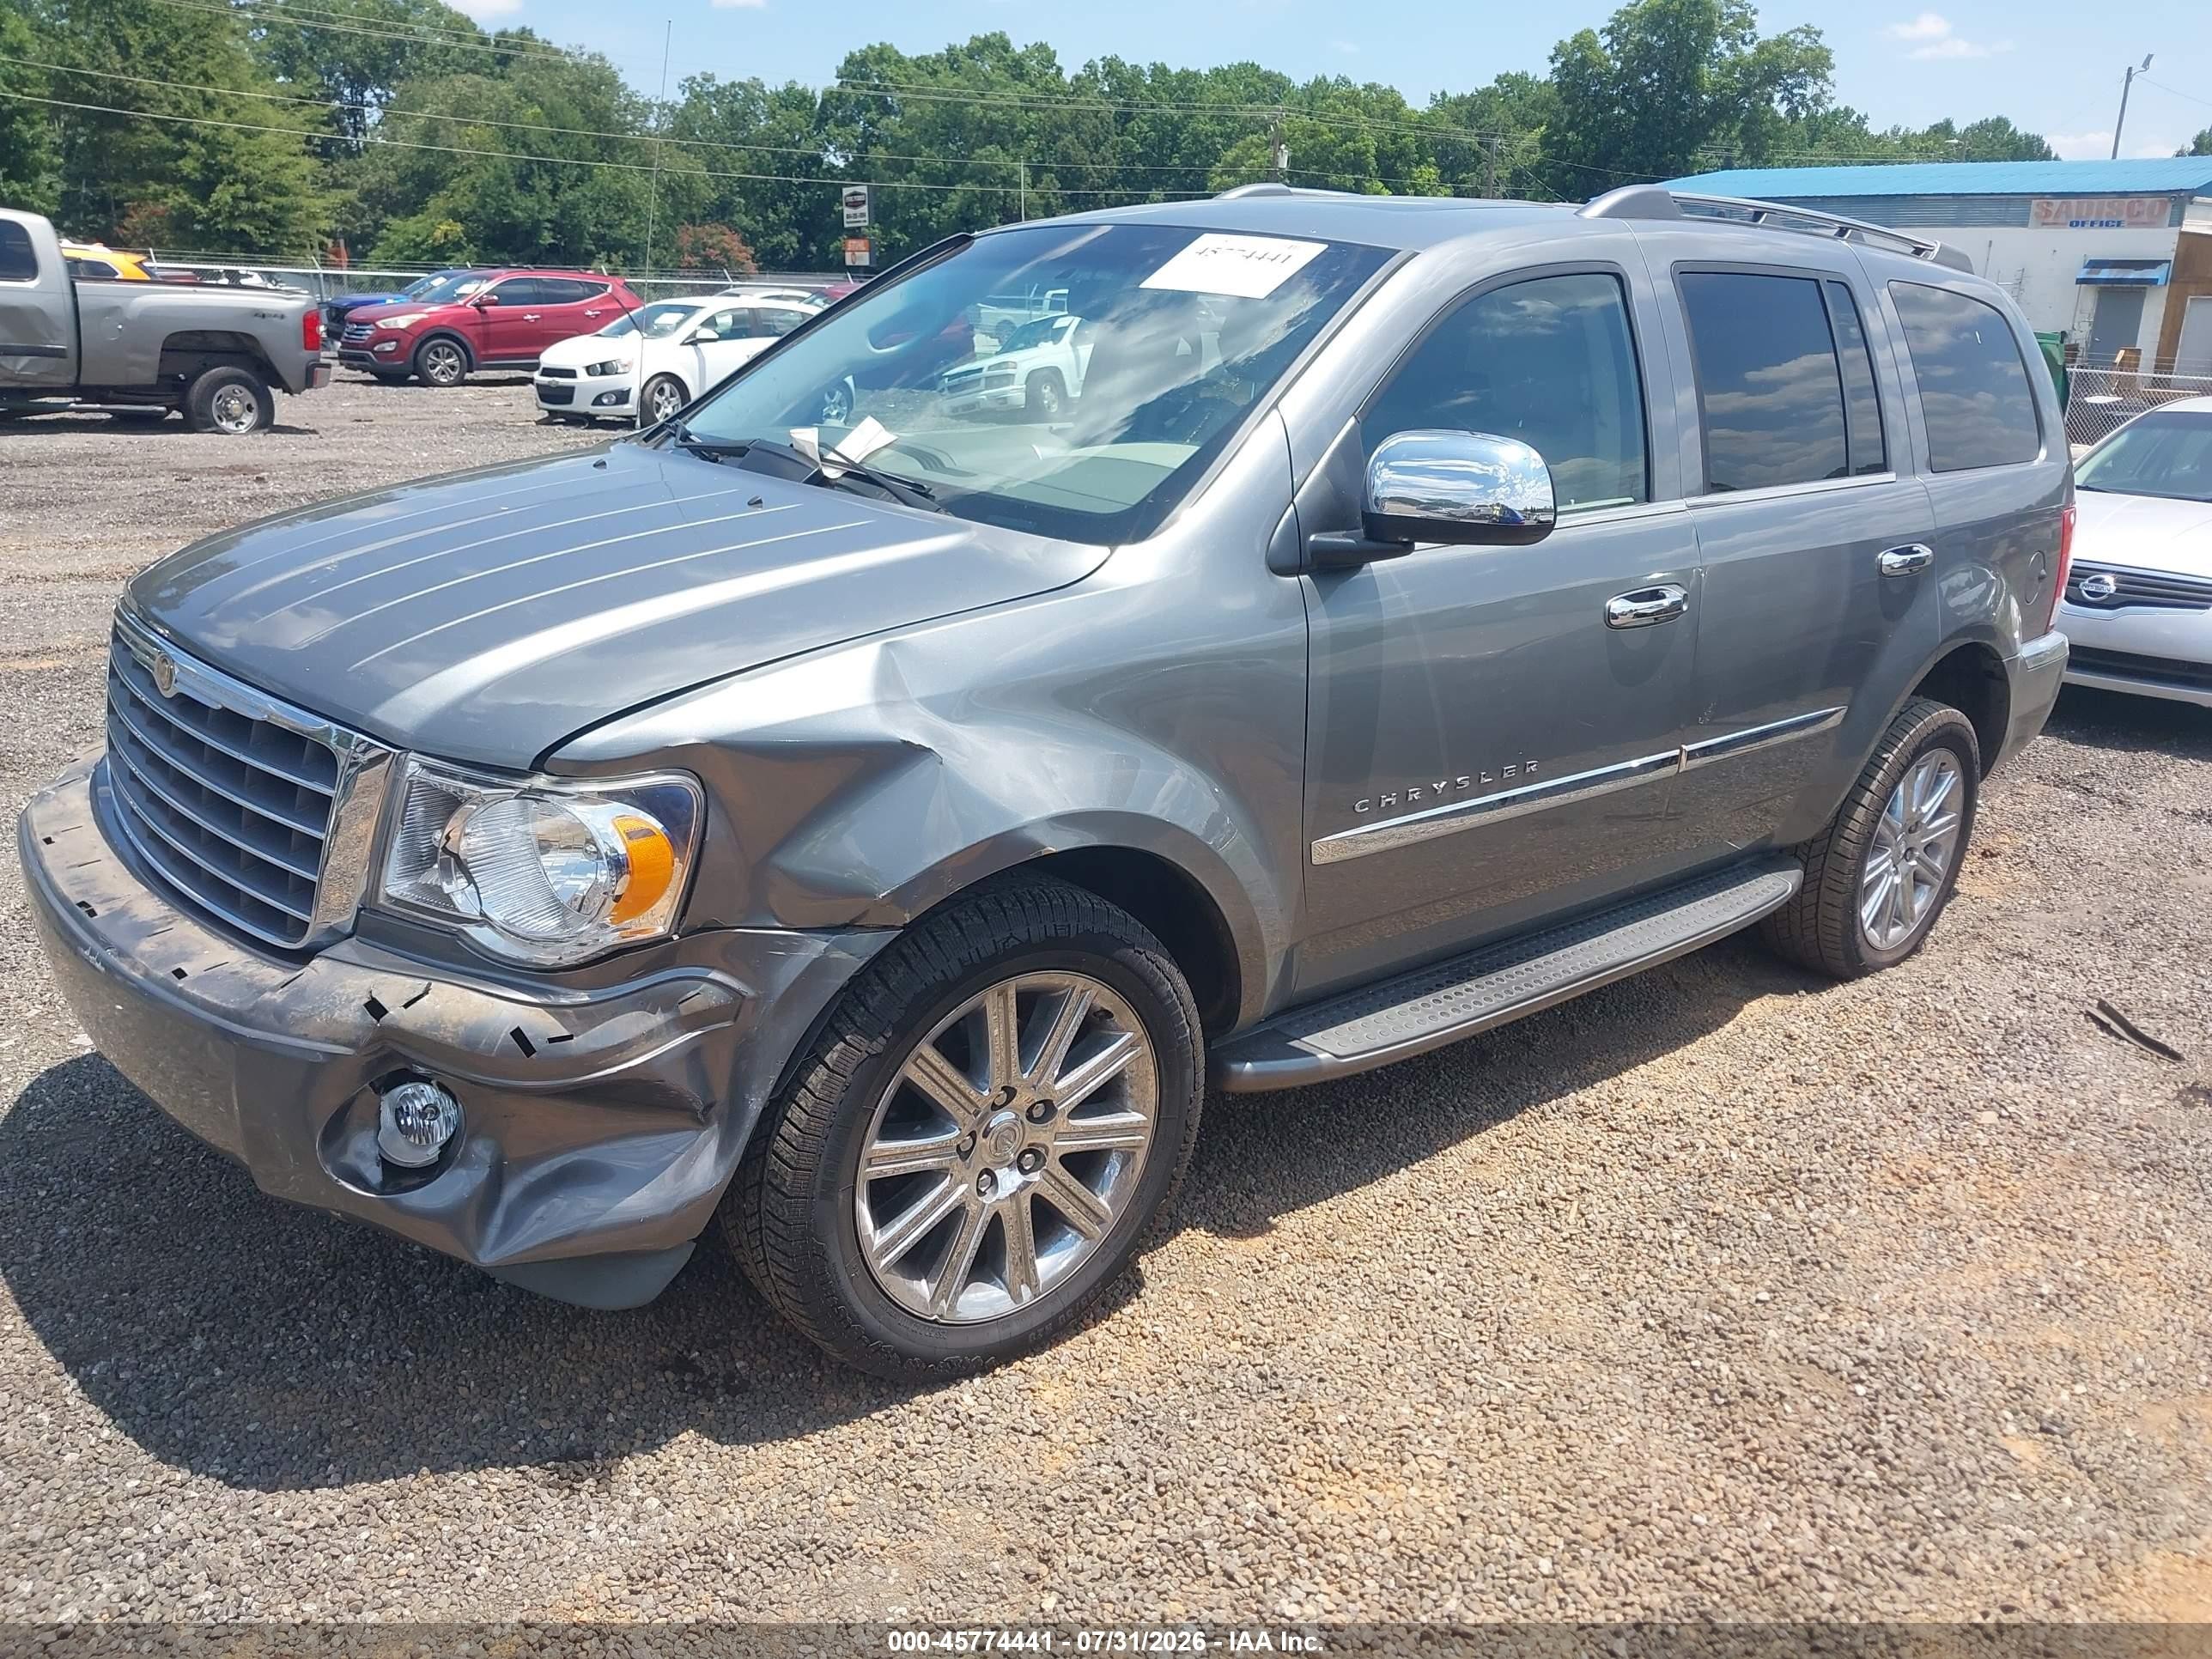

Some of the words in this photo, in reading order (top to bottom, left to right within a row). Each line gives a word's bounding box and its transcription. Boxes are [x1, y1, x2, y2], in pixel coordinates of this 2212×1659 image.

[2033, 198, 2168, 221] SADISCO
[2081, 583, 2112, 592] NISSAN
[1353, 760, 1540, 813] CHRYSLER
